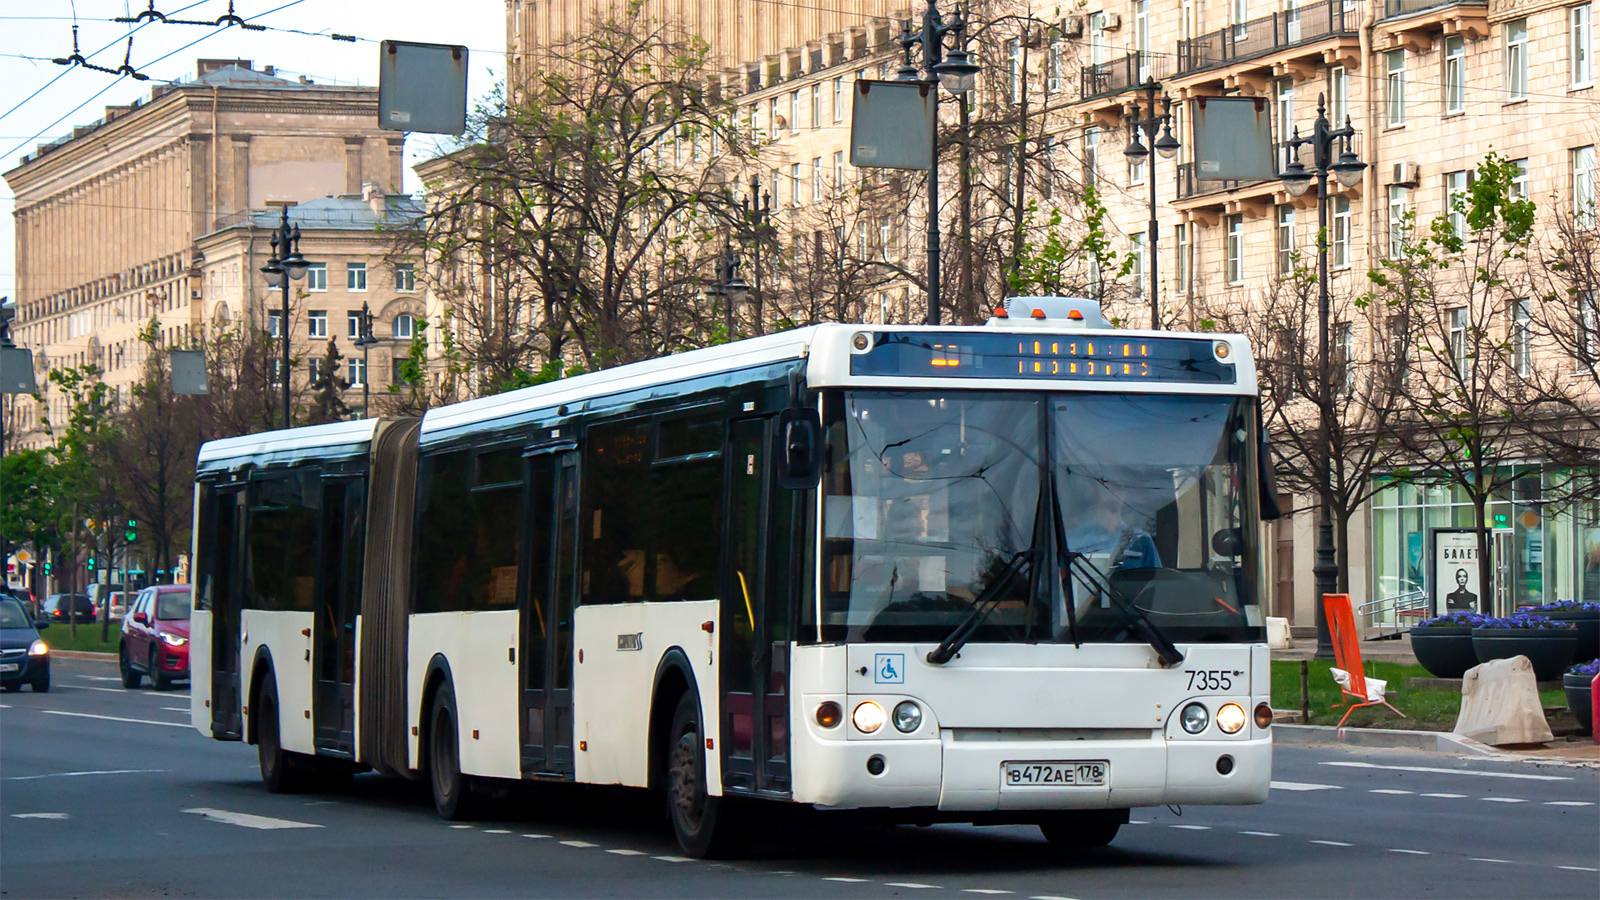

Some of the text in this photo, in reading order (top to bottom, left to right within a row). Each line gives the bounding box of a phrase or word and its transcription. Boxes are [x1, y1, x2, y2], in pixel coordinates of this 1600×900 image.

[1444, 548, 1478, 559] БАЛЕТ
[1184, 670, 1232, 691] 7355
[1077, 765, 1099, 778] 178
